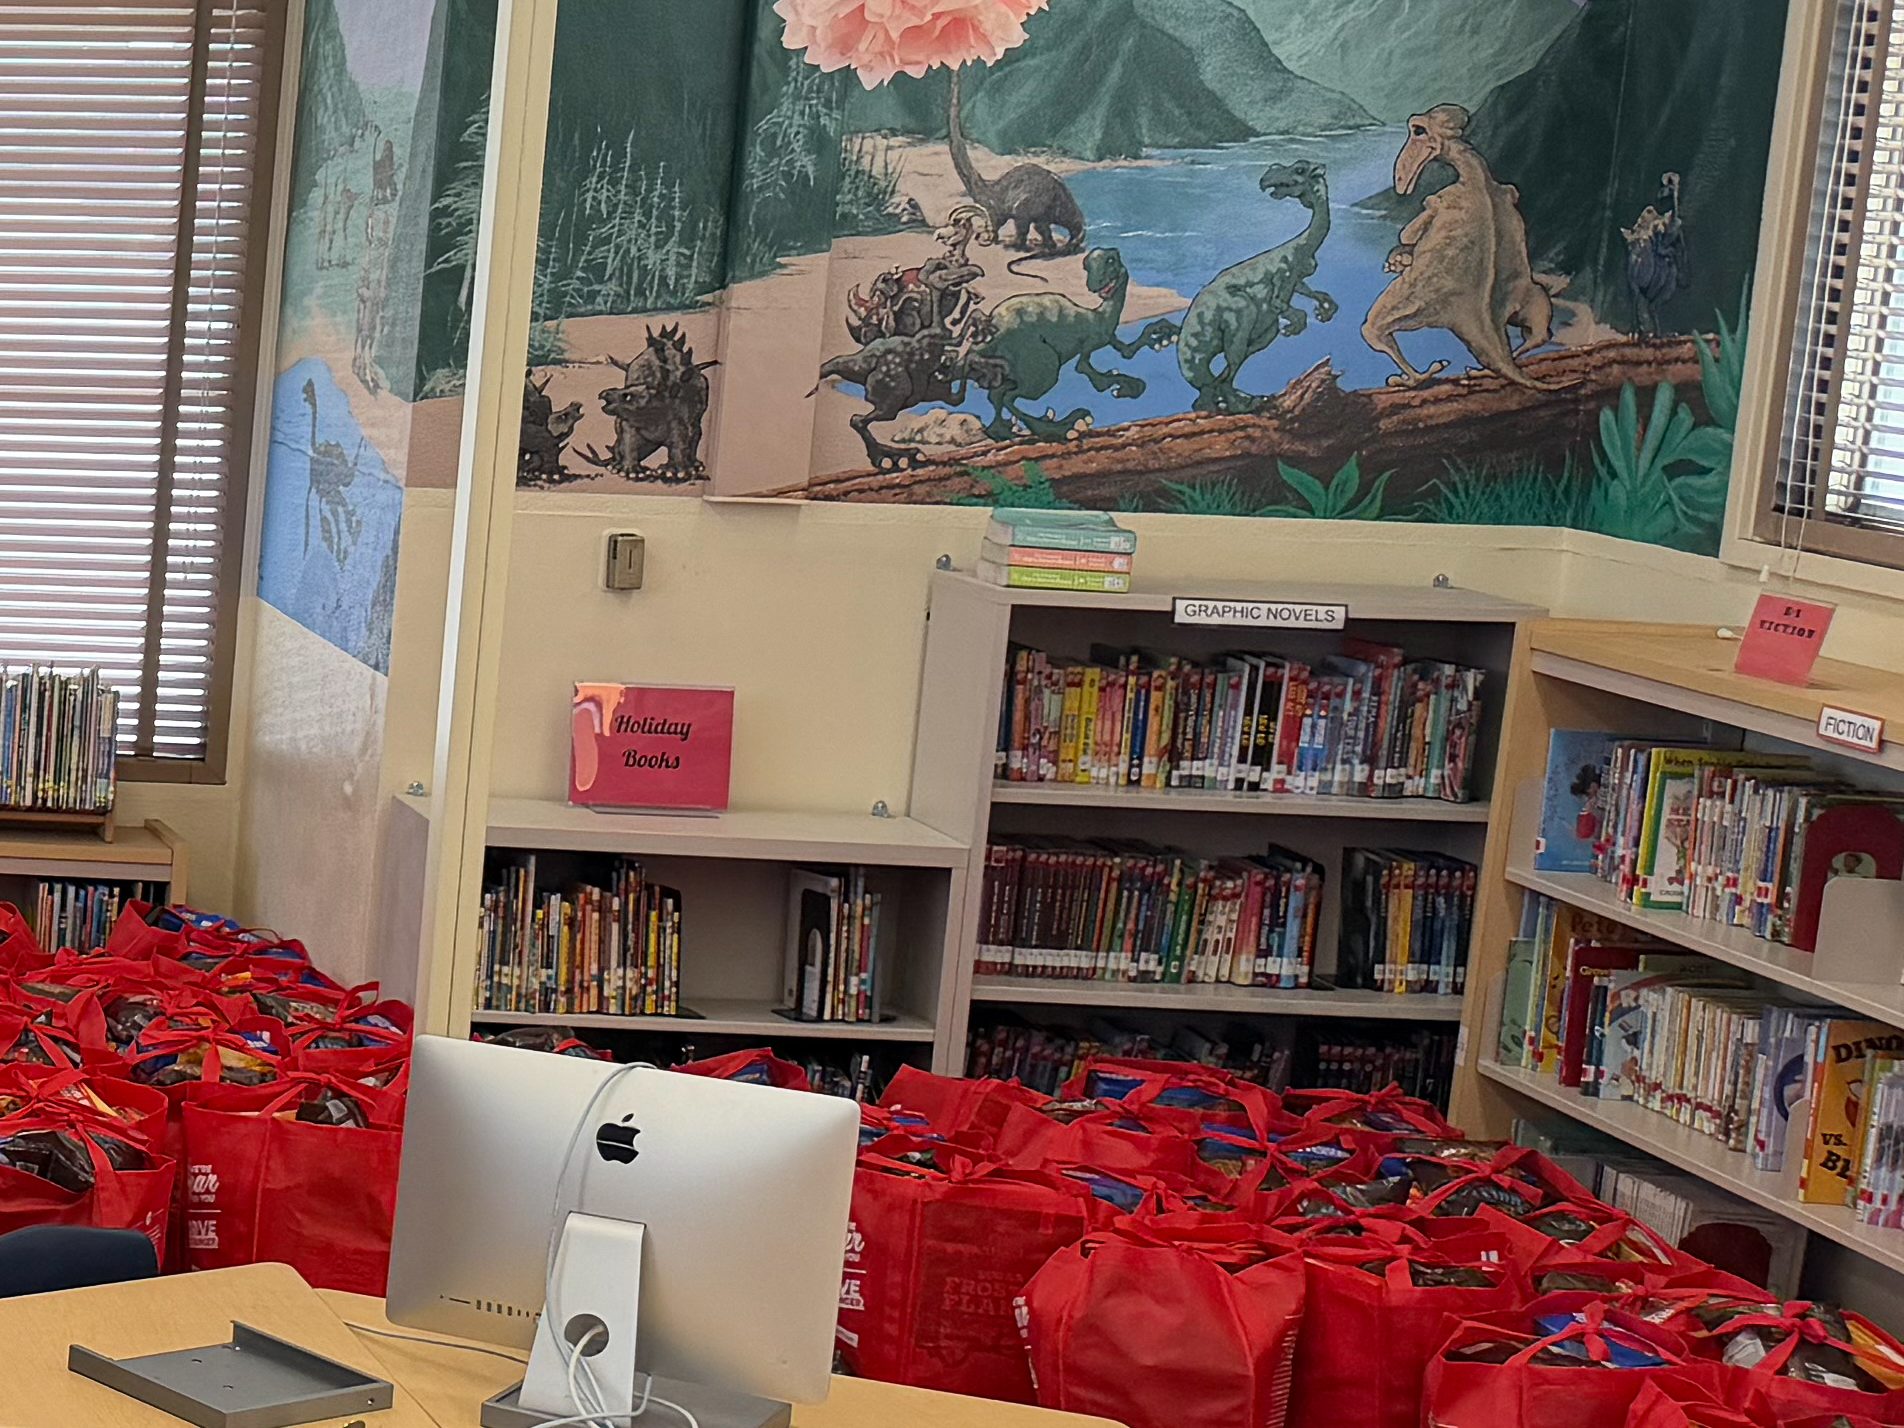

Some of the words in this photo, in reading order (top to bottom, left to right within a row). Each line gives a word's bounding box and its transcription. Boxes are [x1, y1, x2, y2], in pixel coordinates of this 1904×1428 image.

[1184, 603, 1262, 620] GRAPHIC
[1266, 607, 1336, 623] NOVELS
[615, 715, 692, 742] Holiday
[1824, 716, 1876, 743] FICTION
[622, 748, 681, 770] Books
